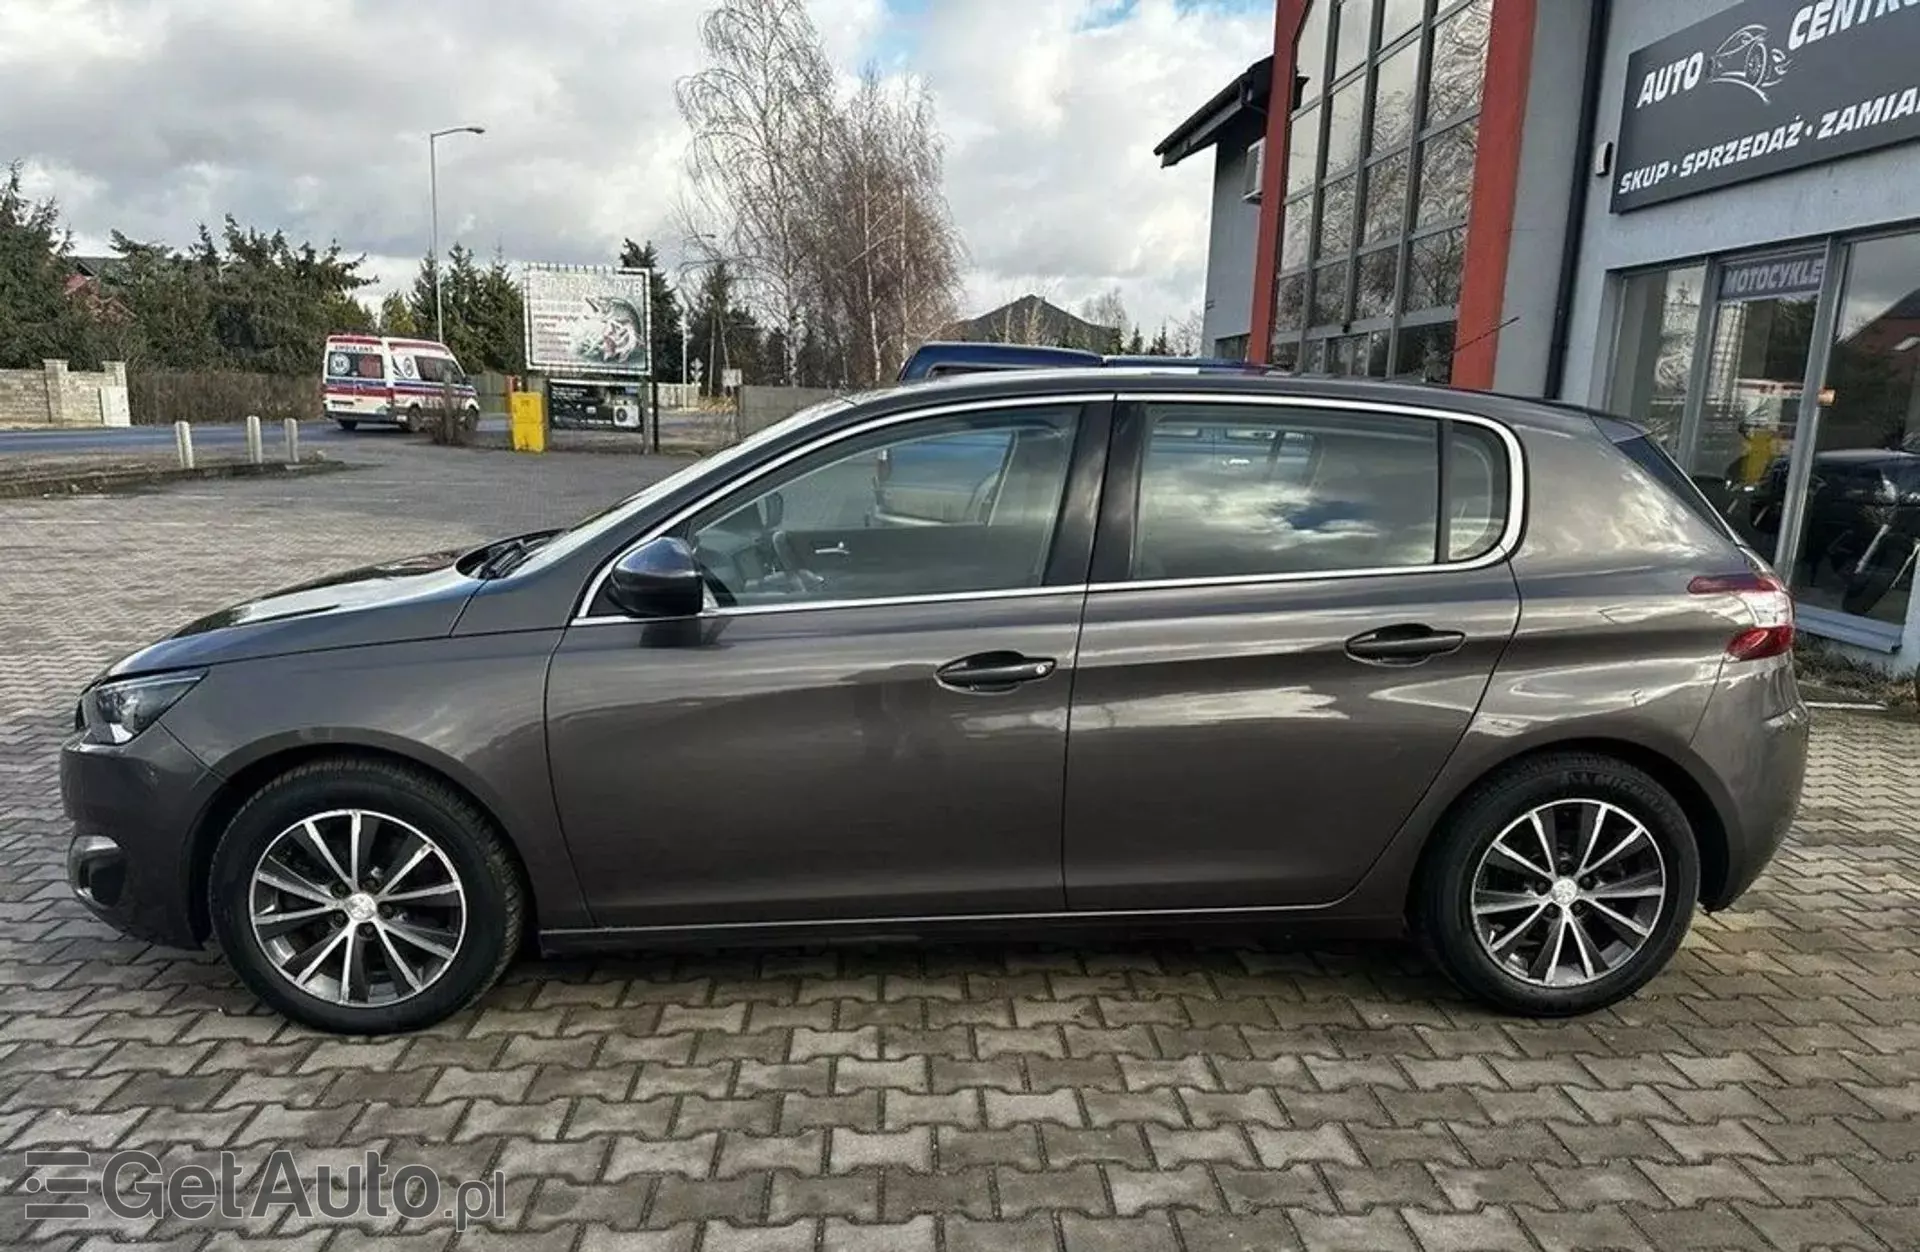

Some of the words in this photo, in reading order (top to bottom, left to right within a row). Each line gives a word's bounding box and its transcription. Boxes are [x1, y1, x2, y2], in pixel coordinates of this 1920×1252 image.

[1636, 52, 1704, 108] AUTO
[1618, 161, 1671, 195] SKUP
[1680, 115, 1804, 178] SPRZEDAŻ
[1817, 87, 1920, 140] ZAMIA
[1723, 259, 1825, 293] MOTOCYKLE
